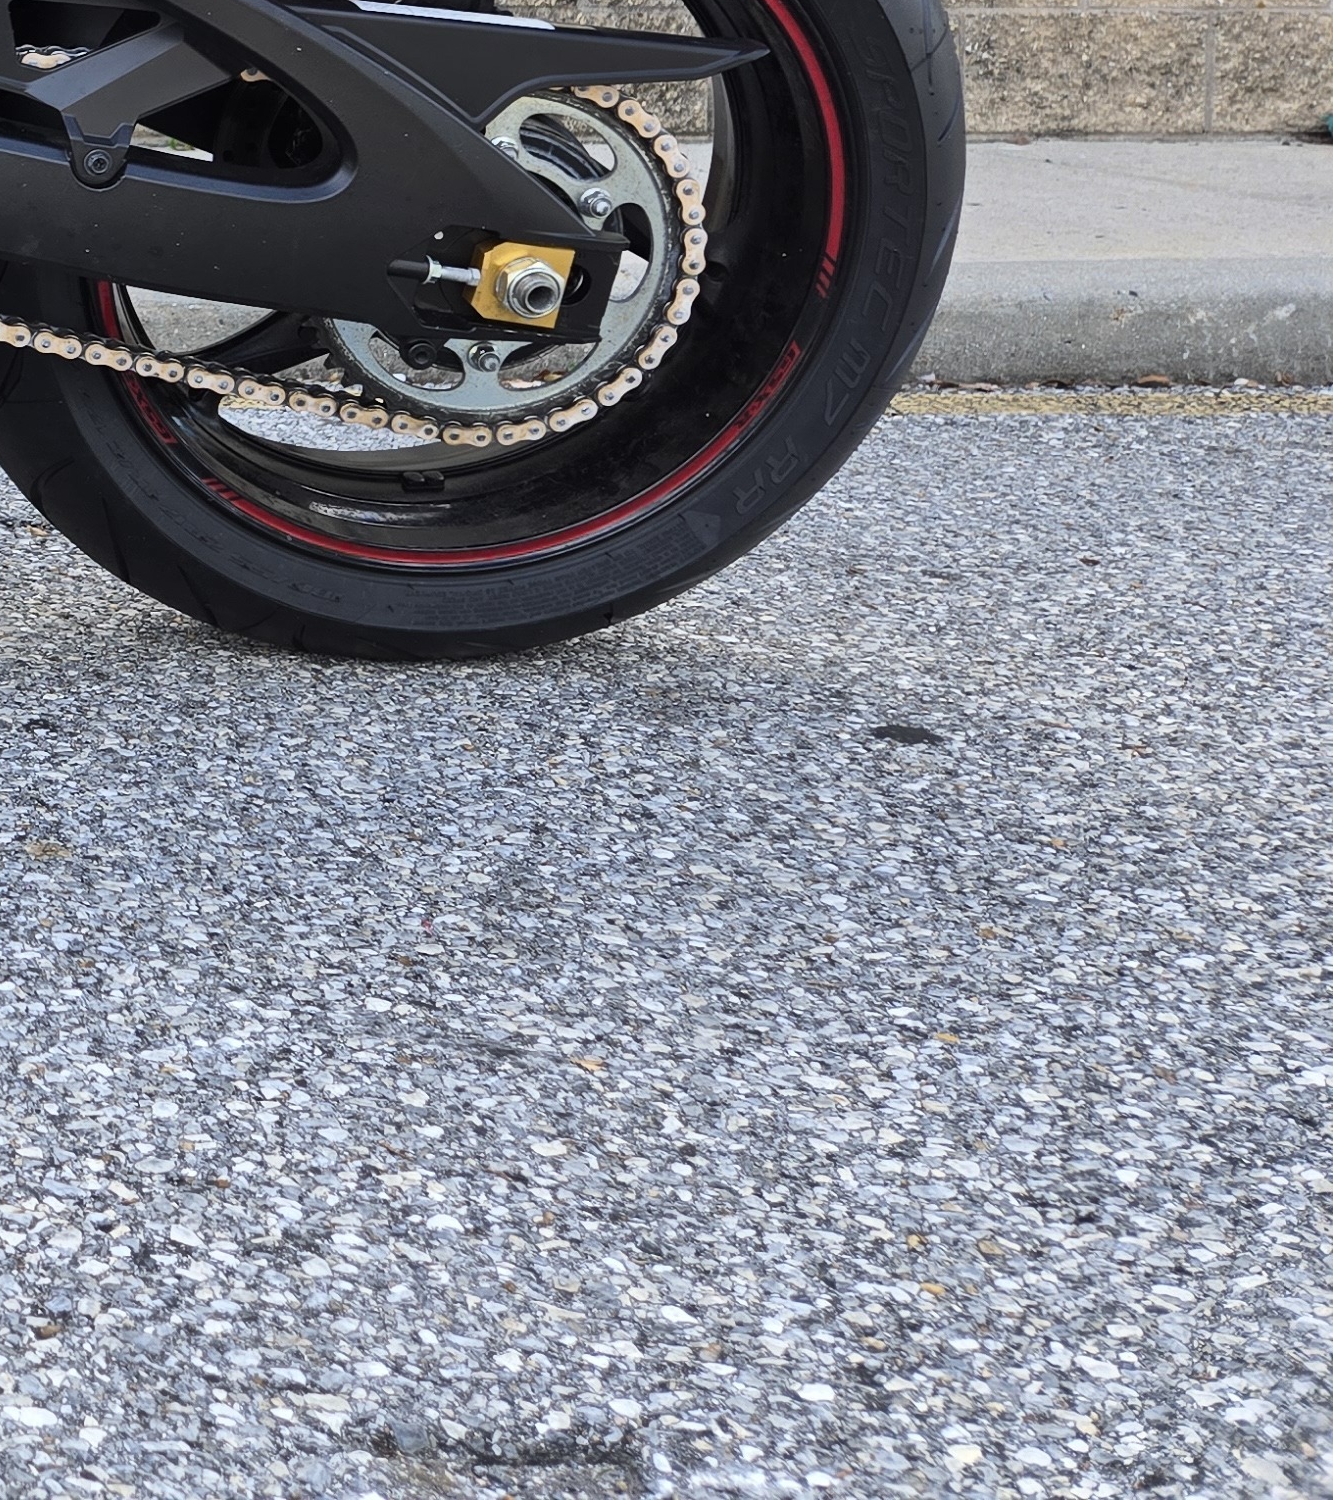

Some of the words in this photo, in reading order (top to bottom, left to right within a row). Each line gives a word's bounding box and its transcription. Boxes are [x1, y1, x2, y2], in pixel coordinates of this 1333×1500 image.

[850, 30, 911, 332] SPORTEC
[821, 338, 874, 427] M7
[732, 436, 810, 517] RR
